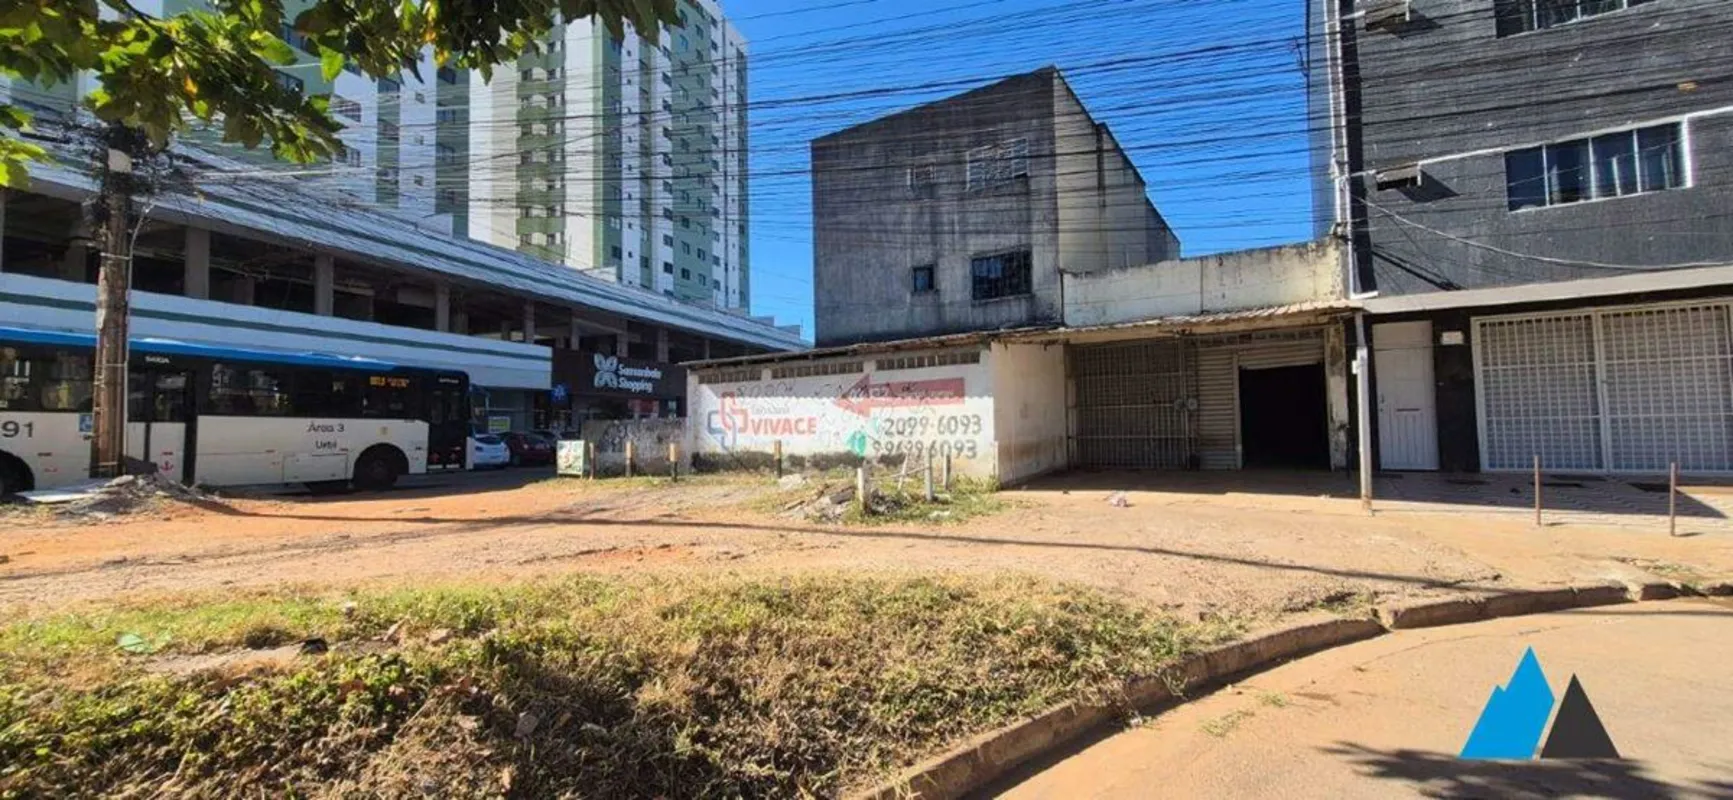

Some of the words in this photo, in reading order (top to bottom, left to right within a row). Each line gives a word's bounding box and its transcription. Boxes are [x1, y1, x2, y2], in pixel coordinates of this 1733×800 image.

[619, 378, 653, 393] Shopping
[1, 420, 33, 438] 91
[336, 422, 345, 432] 3
[751, 417, 817, 435] VIVACE
